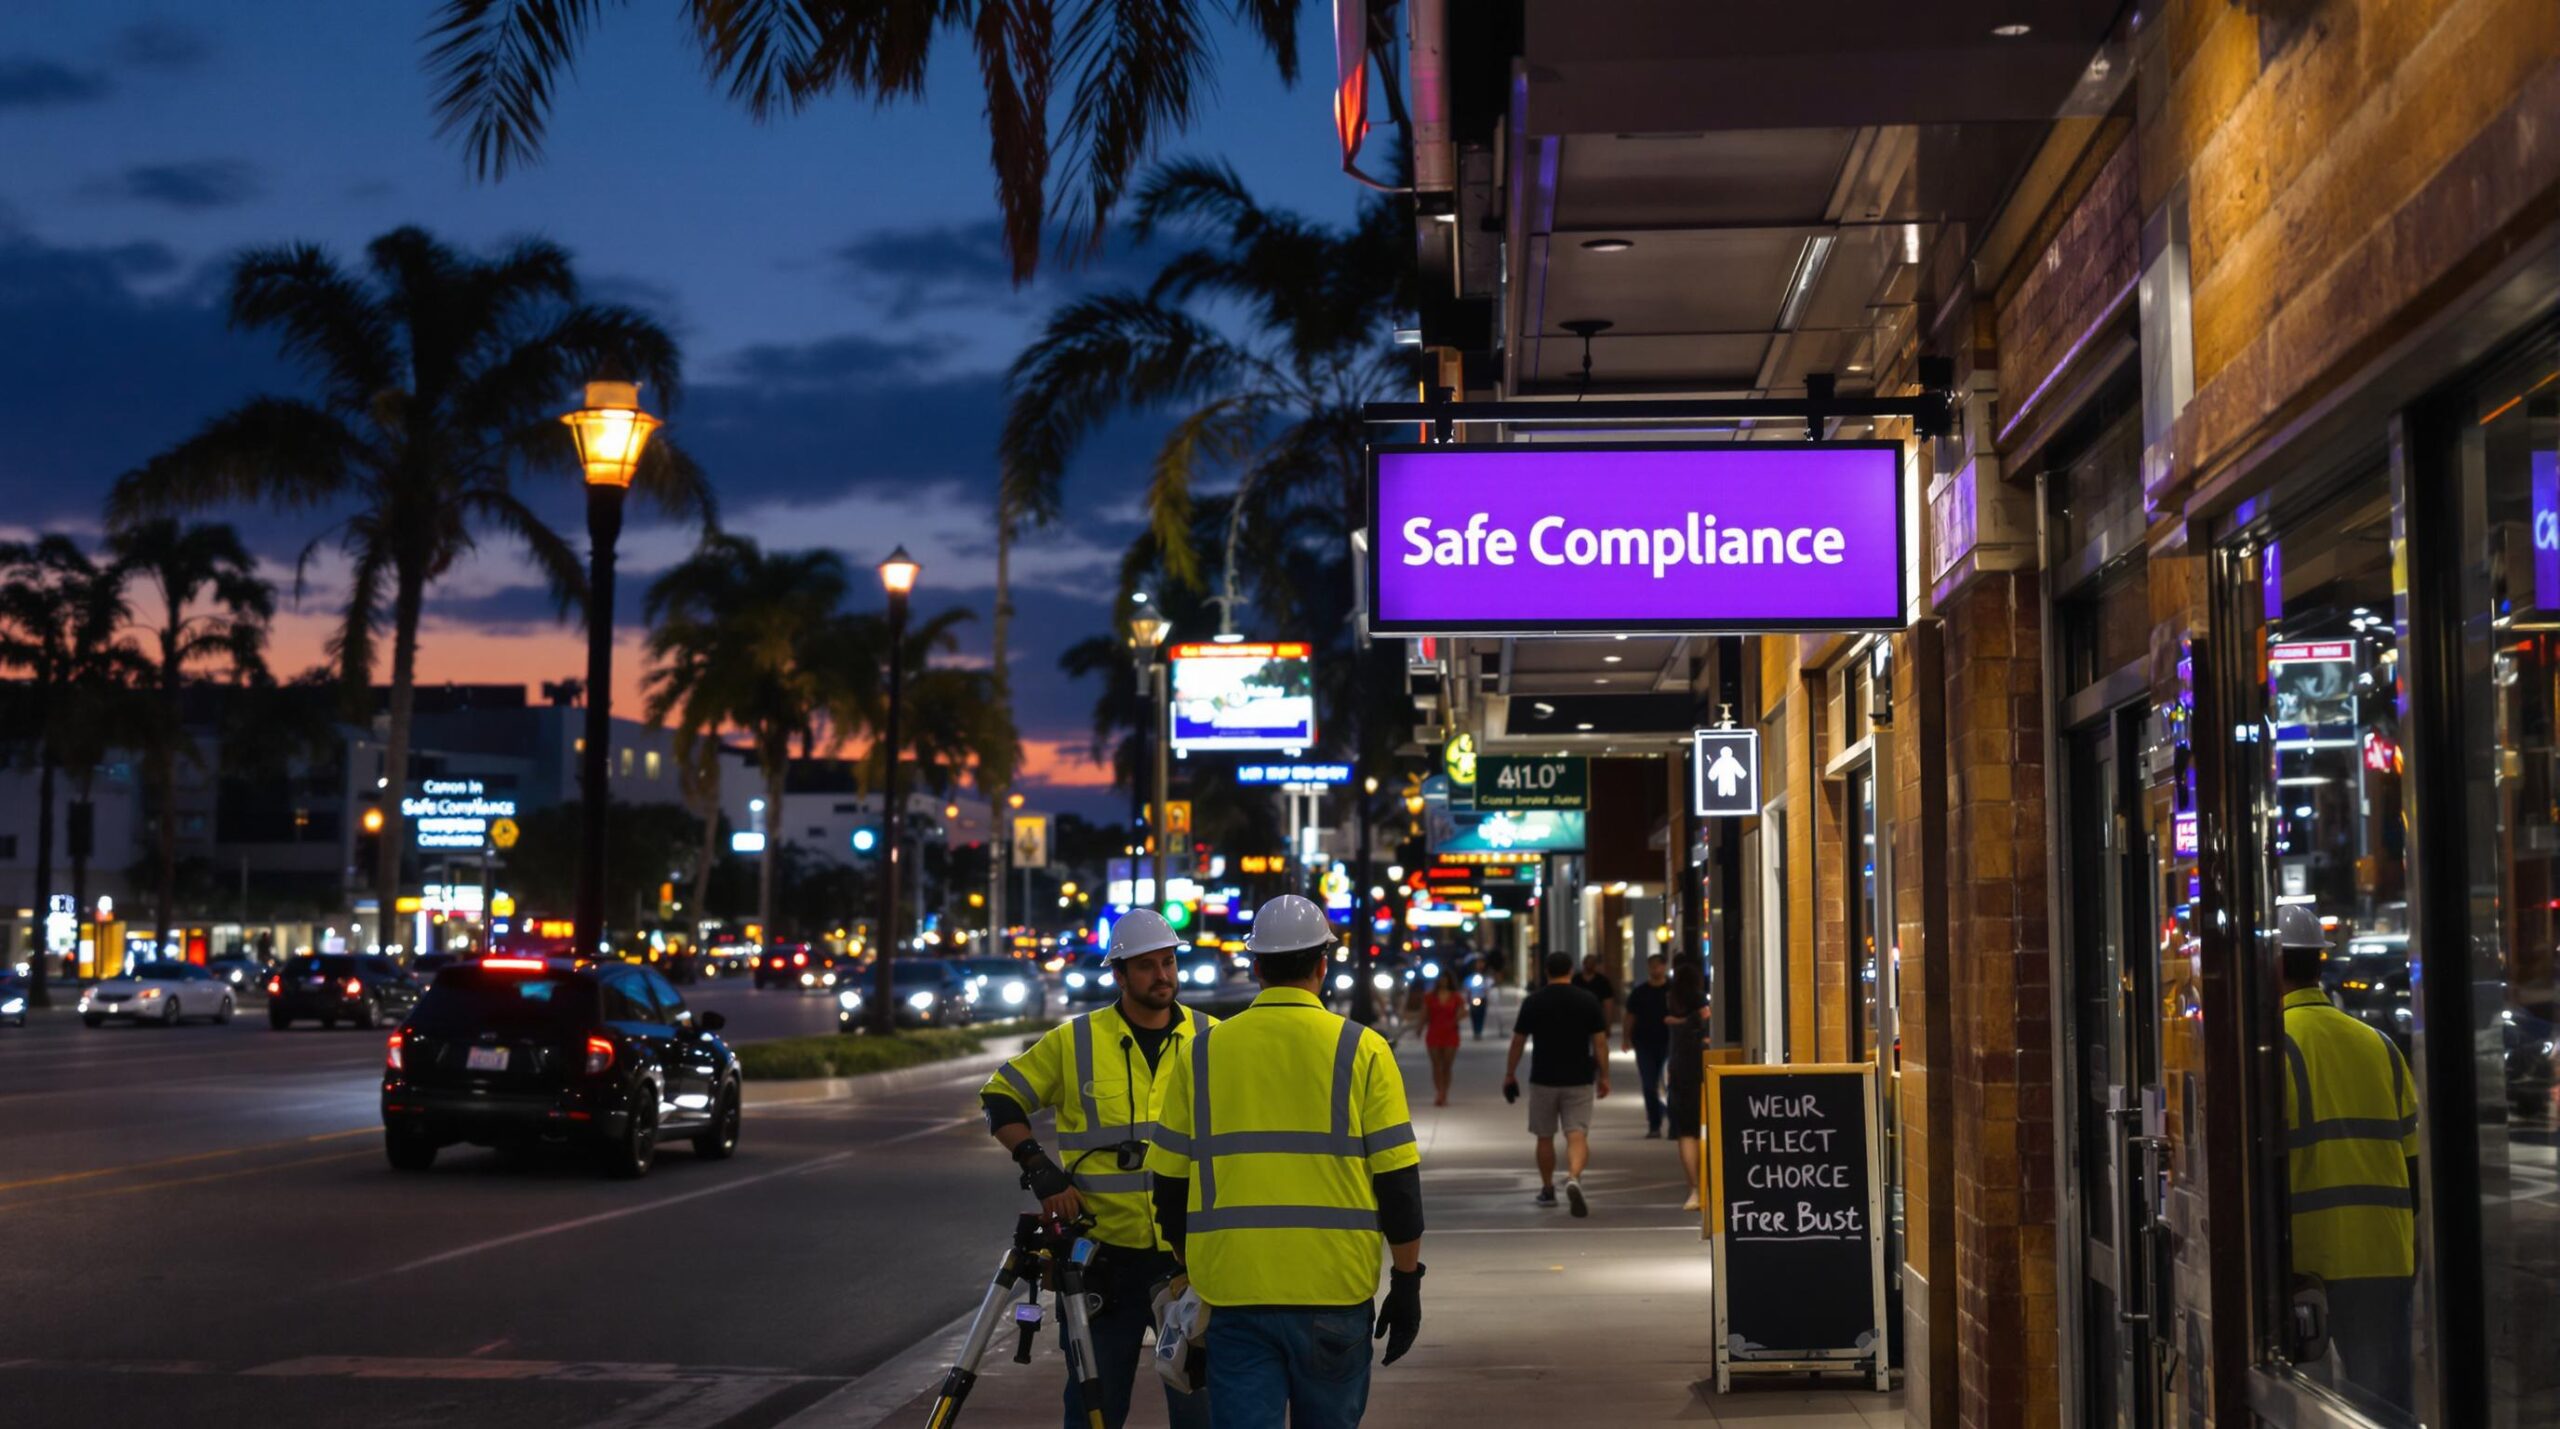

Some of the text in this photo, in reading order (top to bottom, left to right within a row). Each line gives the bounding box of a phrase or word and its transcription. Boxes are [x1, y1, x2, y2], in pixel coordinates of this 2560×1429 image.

[1402, 512, 1846, 579] Safe Compliance
[1748, 1094, 1825, 1120] WEUR
[1741, 1128, 1837, 1155] FFLECT
[1747, 1163, 1850, 1189] CHORCE
[1730, 1200, 1863, 1232] Free Bust
